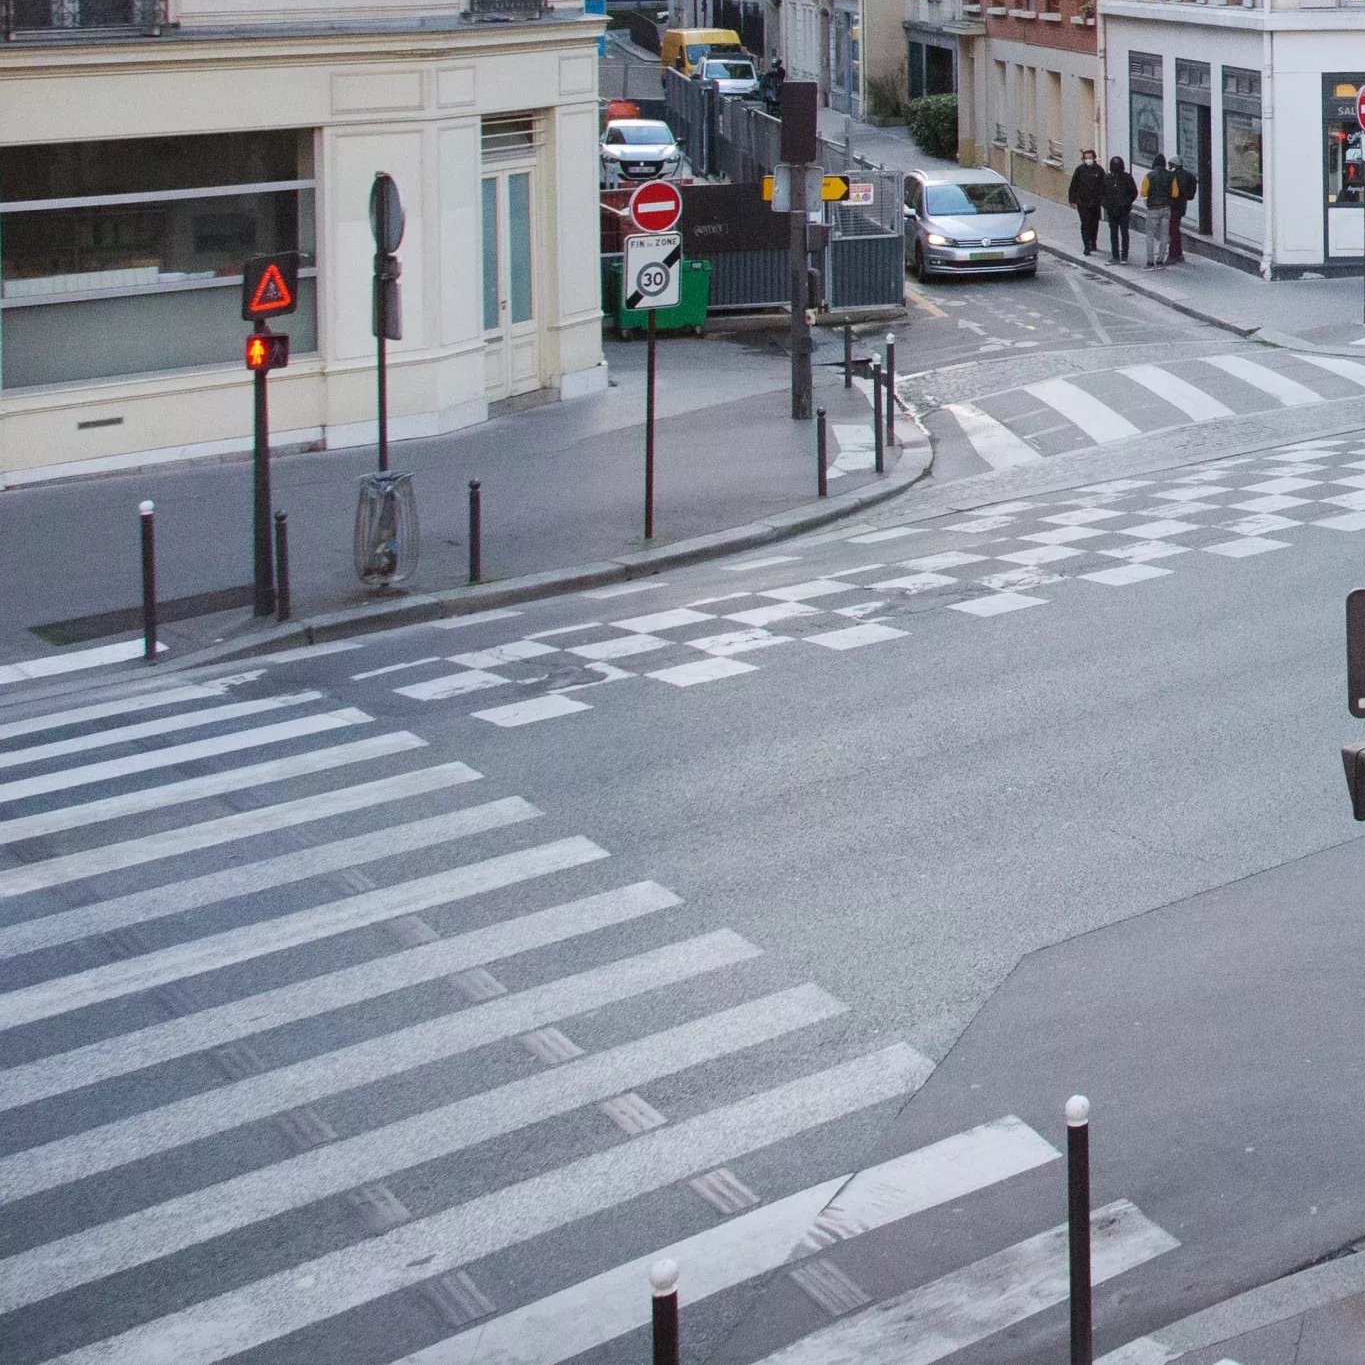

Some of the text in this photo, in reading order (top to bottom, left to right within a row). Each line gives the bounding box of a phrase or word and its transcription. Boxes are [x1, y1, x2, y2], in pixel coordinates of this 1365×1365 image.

[1338, 106, 1356, 115] SAL
[630, 240, 645, 248] FIN
[655, 238, 678, 247] ZONE
[643, 272, 664, 287] 30
